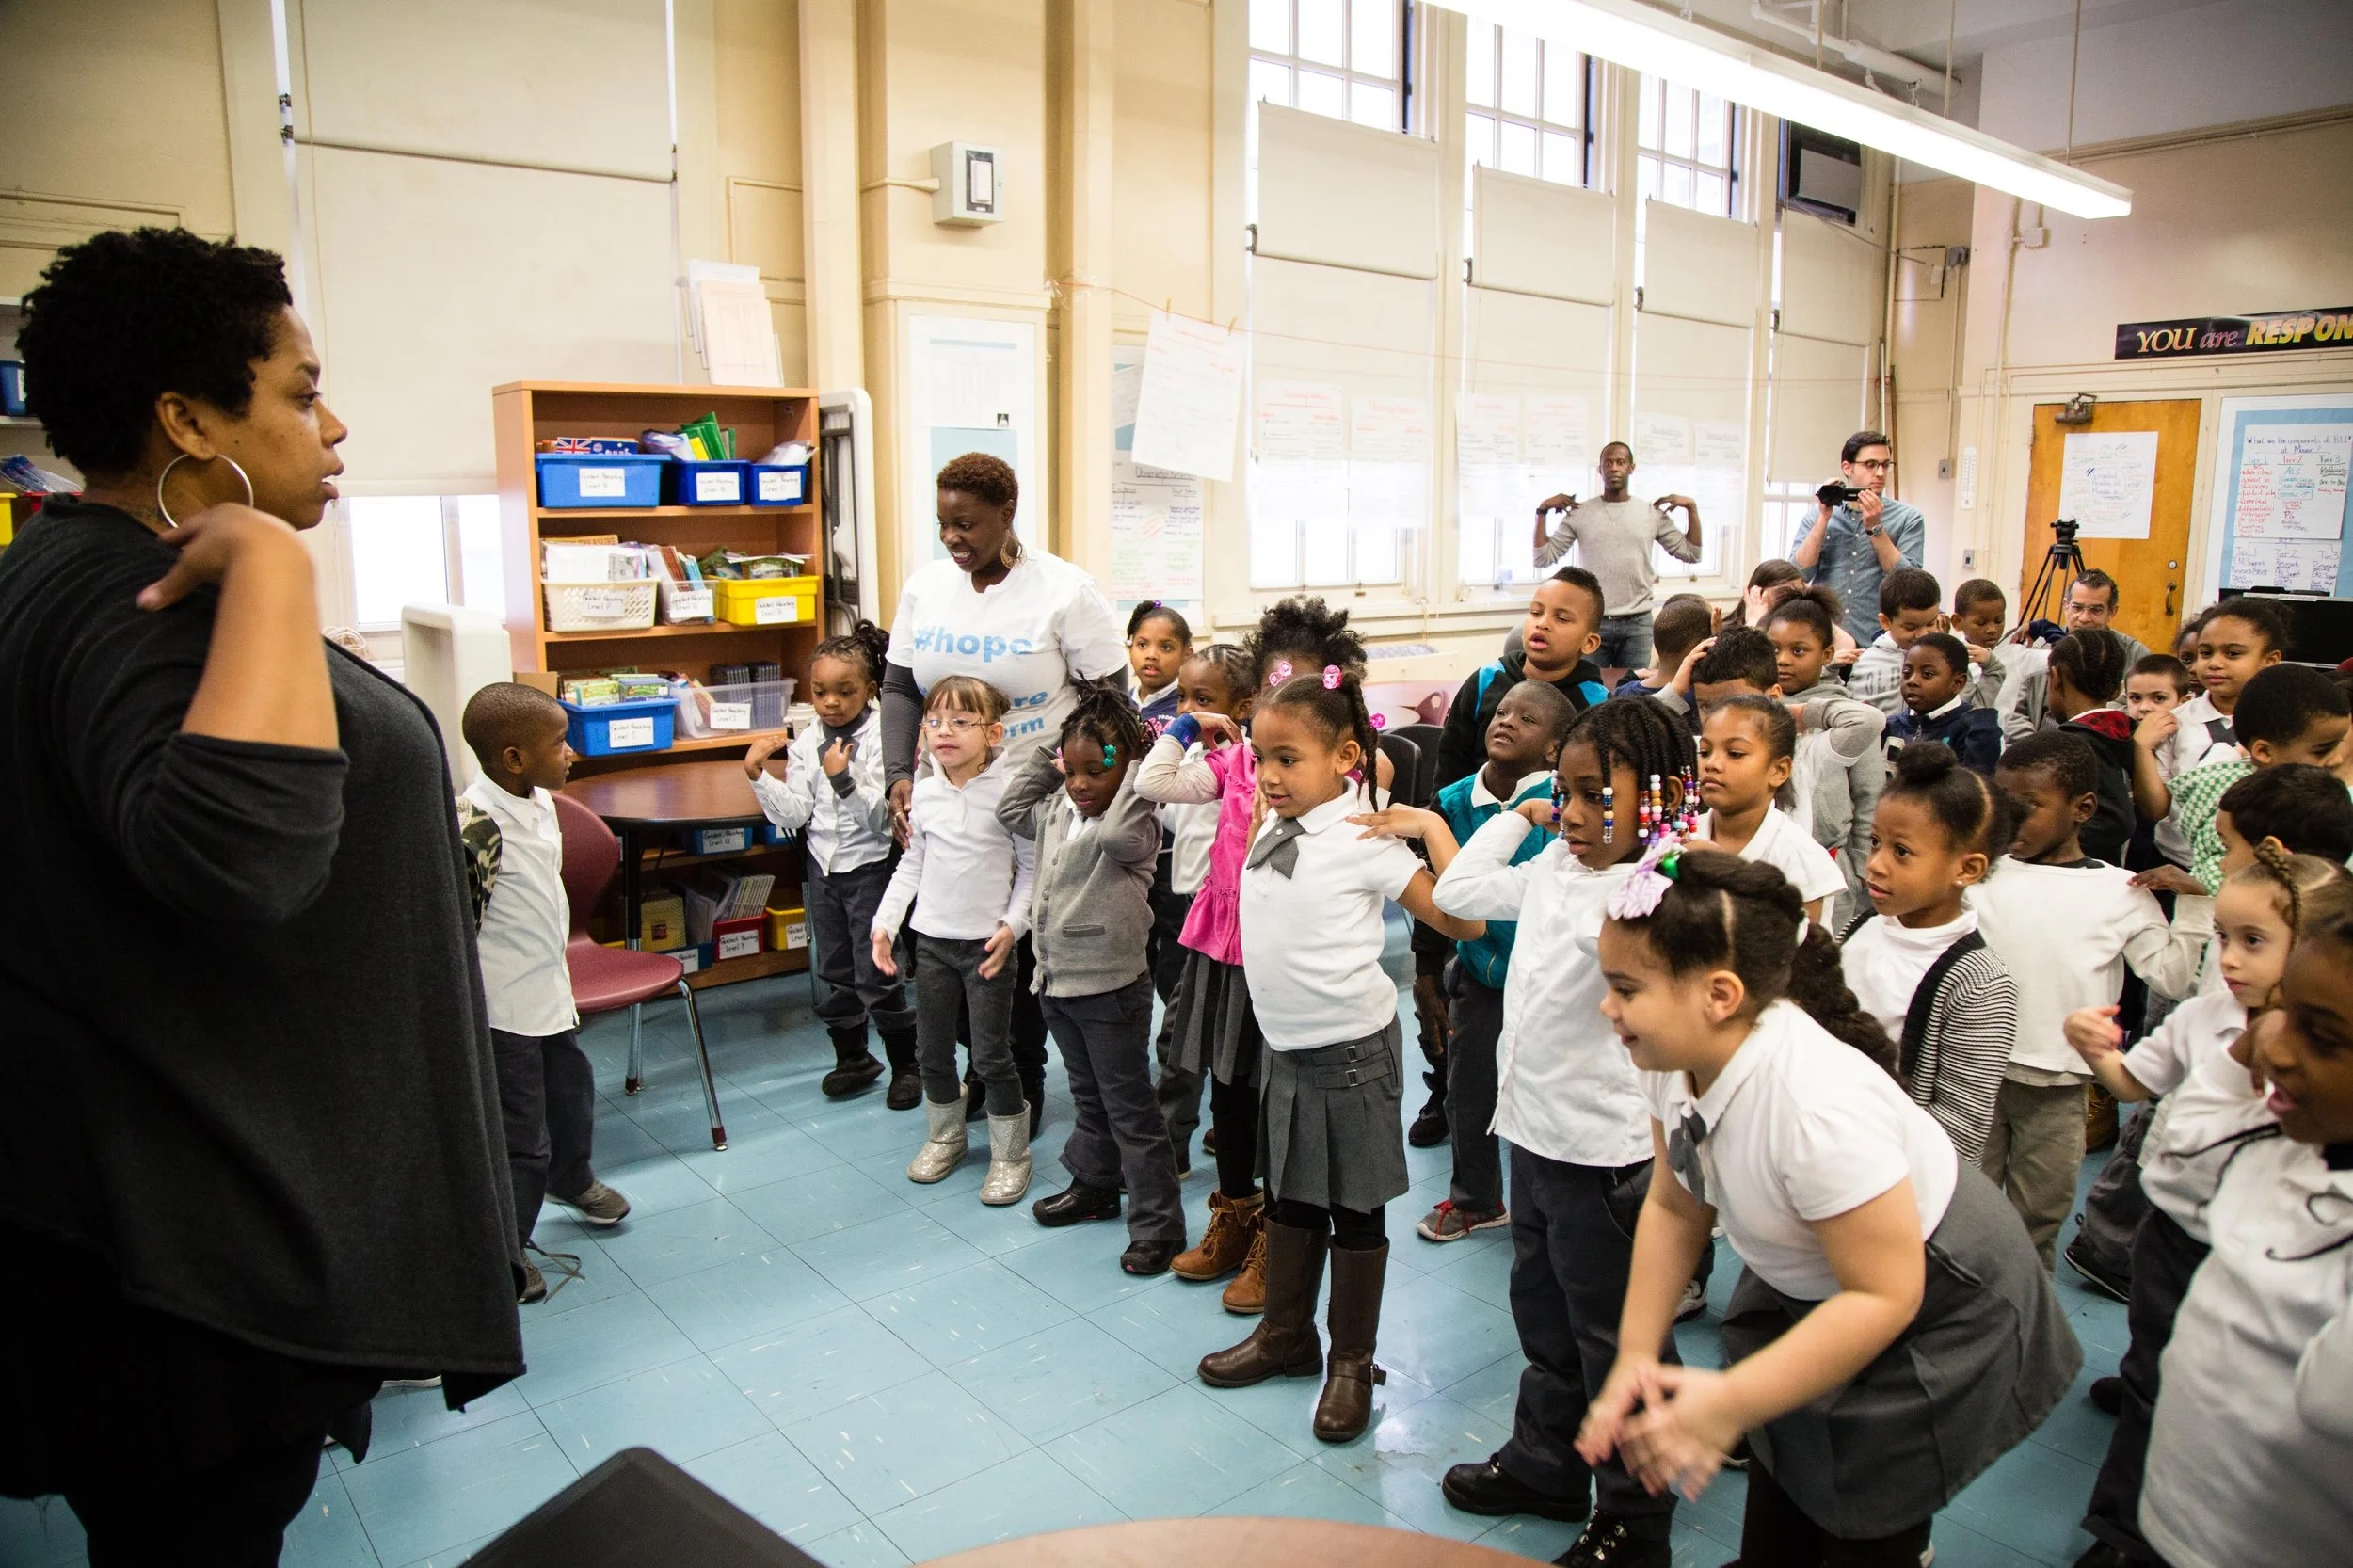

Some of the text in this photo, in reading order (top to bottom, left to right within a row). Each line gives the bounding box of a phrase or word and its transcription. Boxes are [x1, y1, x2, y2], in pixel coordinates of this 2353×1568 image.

[2137, 315, 2353, 353] YOU are RESPON
